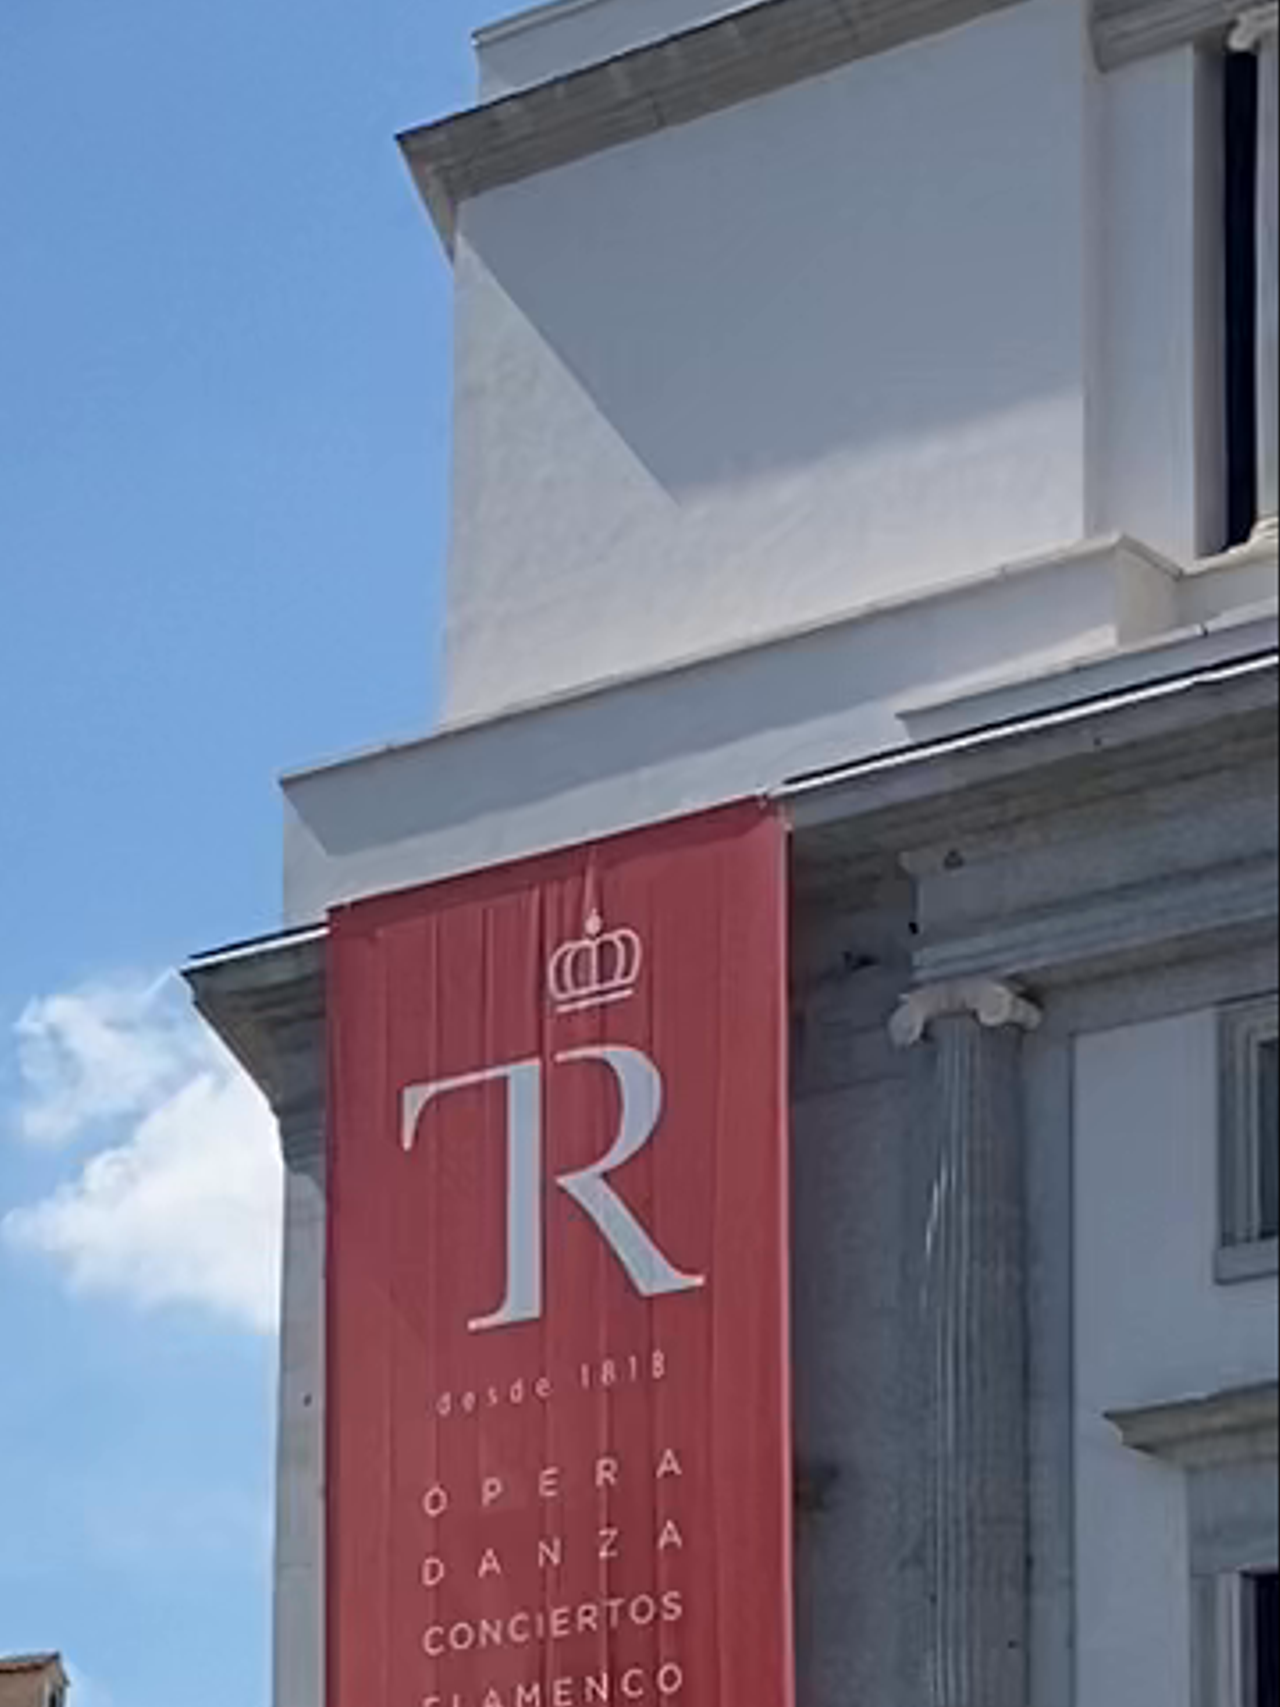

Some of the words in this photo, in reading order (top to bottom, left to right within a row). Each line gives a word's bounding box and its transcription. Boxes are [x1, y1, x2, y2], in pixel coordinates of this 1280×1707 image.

[402, 1043, 706, 1332] TR
[436, 1377, 552, 1416] desde
[581, 1348, 665, 1390] 1818
[423, 1448, 682, 1518] OPERA
[422, 1520, 683, 1586] DANZA
[423, 1590, 683, 1657] CONCIERTOS
